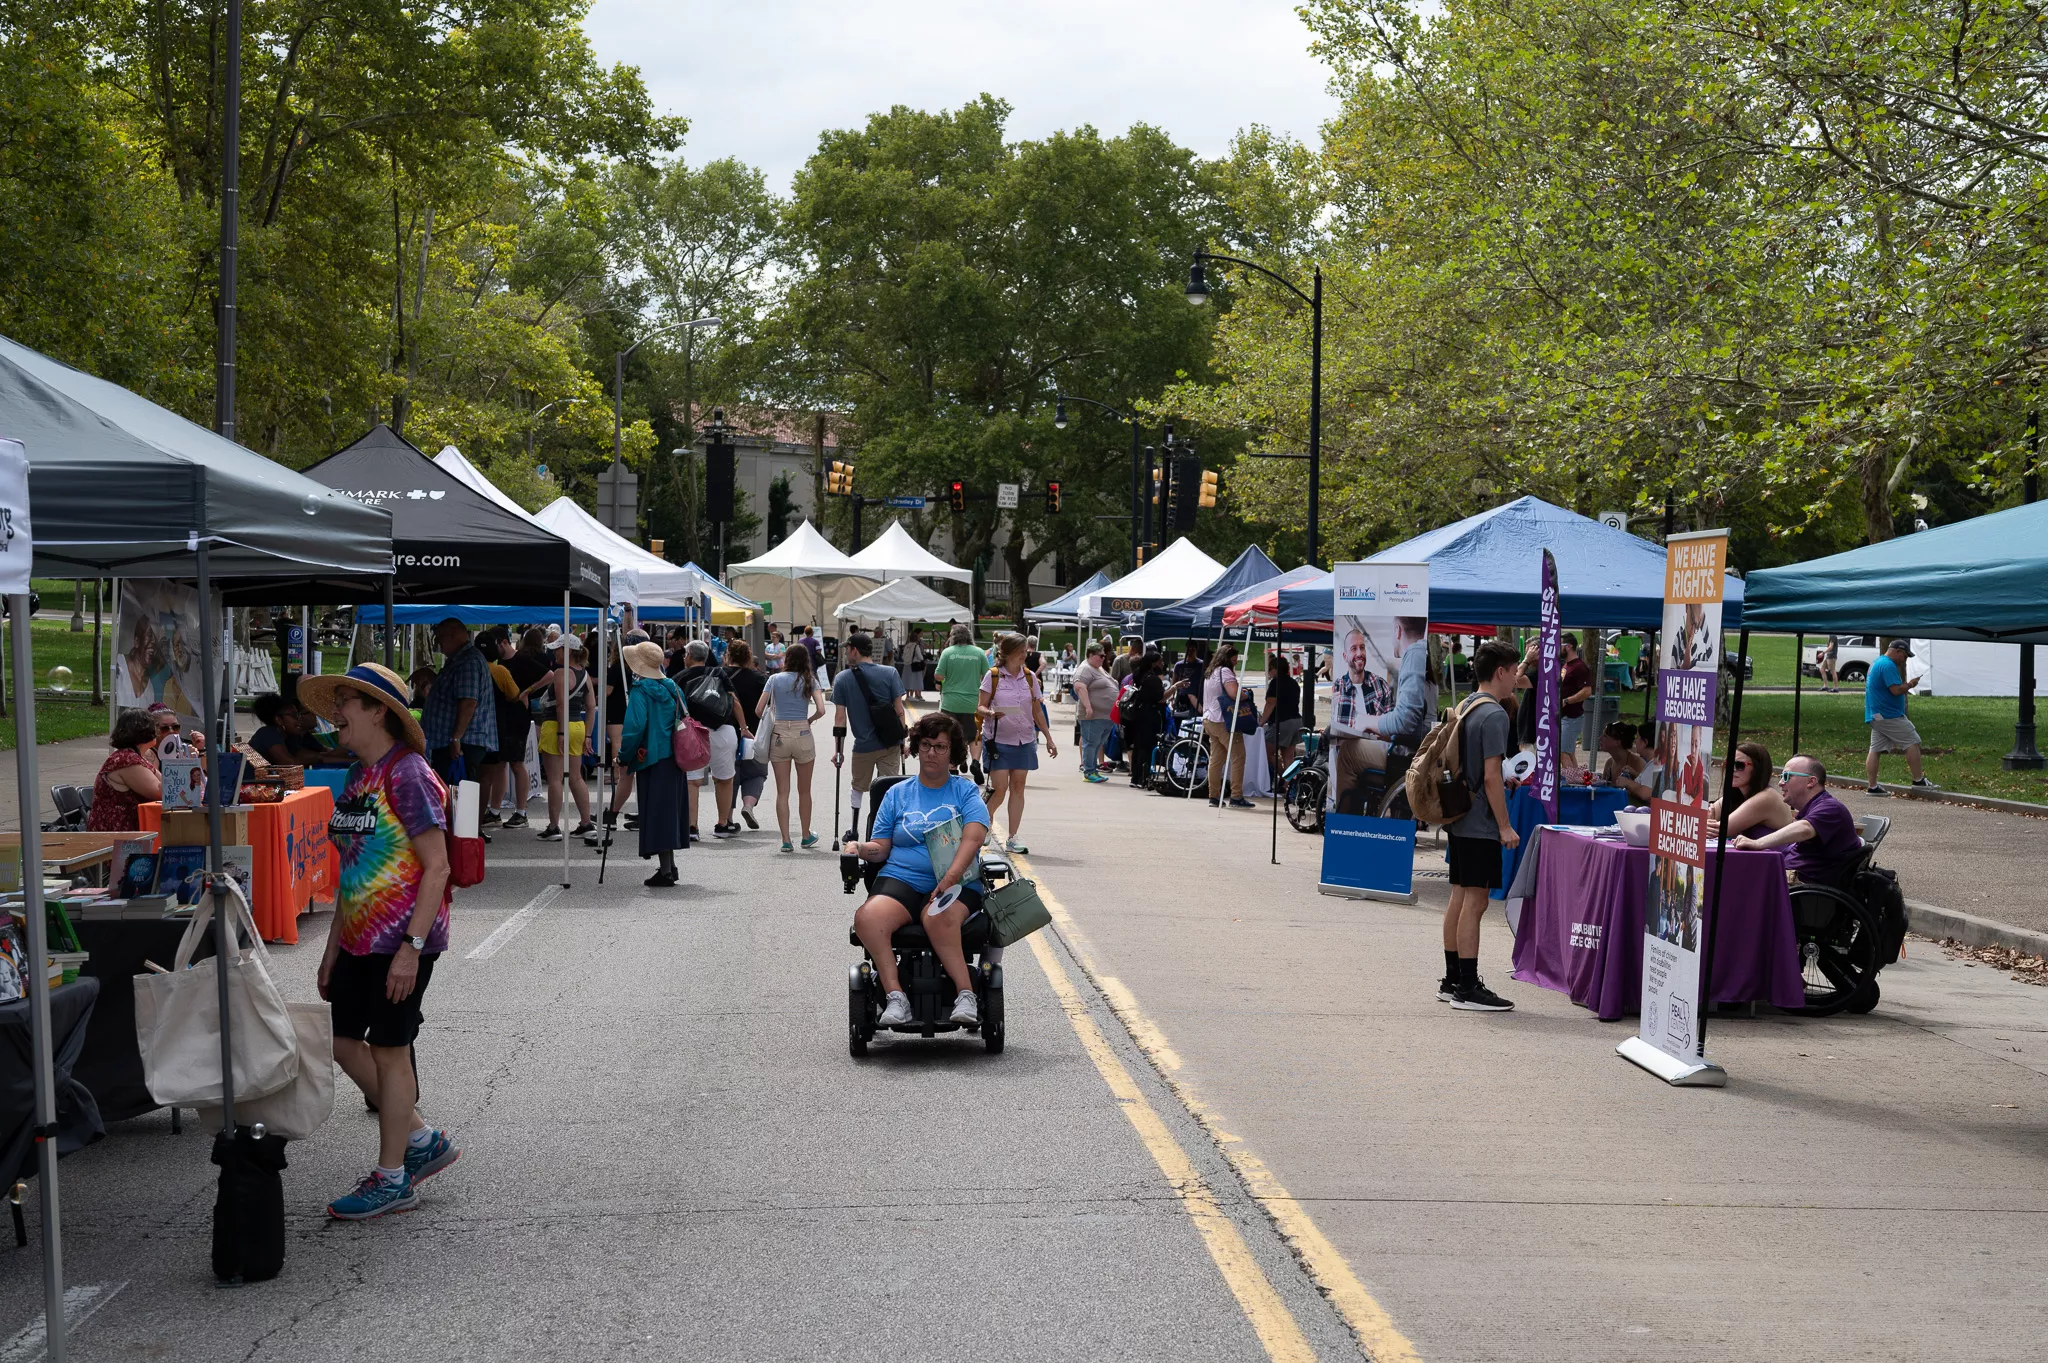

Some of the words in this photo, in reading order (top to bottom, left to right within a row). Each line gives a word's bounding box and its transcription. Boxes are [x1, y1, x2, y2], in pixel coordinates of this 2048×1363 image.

[1674, 546, 1689, 568] WE
[1691, 544, 1716, 568] HAVE
[1672, 568, 1716, 598] RIGHTS.
[1666, 676, 1680, 698] WE
[1682, 677, 1707, 701] HAVE
[1664, 700, 1707, 721] RESOURCES.
[164, 767, 178, 777] CAN
[172, 778, 186, 787] YOU
[168, 785, 180, 794] SEE
[1660, 809, 1674, 833] WE
[1675, 813, 1699, 840] HAVE
[1330, 829, 1407, 842] www.amerihealthcaritaschc.com
[1658, 834, 1675, 853] EACH
[1676, 838, 1699, 860] OTHER.
[1671, 1003, 1684, 1020] PEAL
